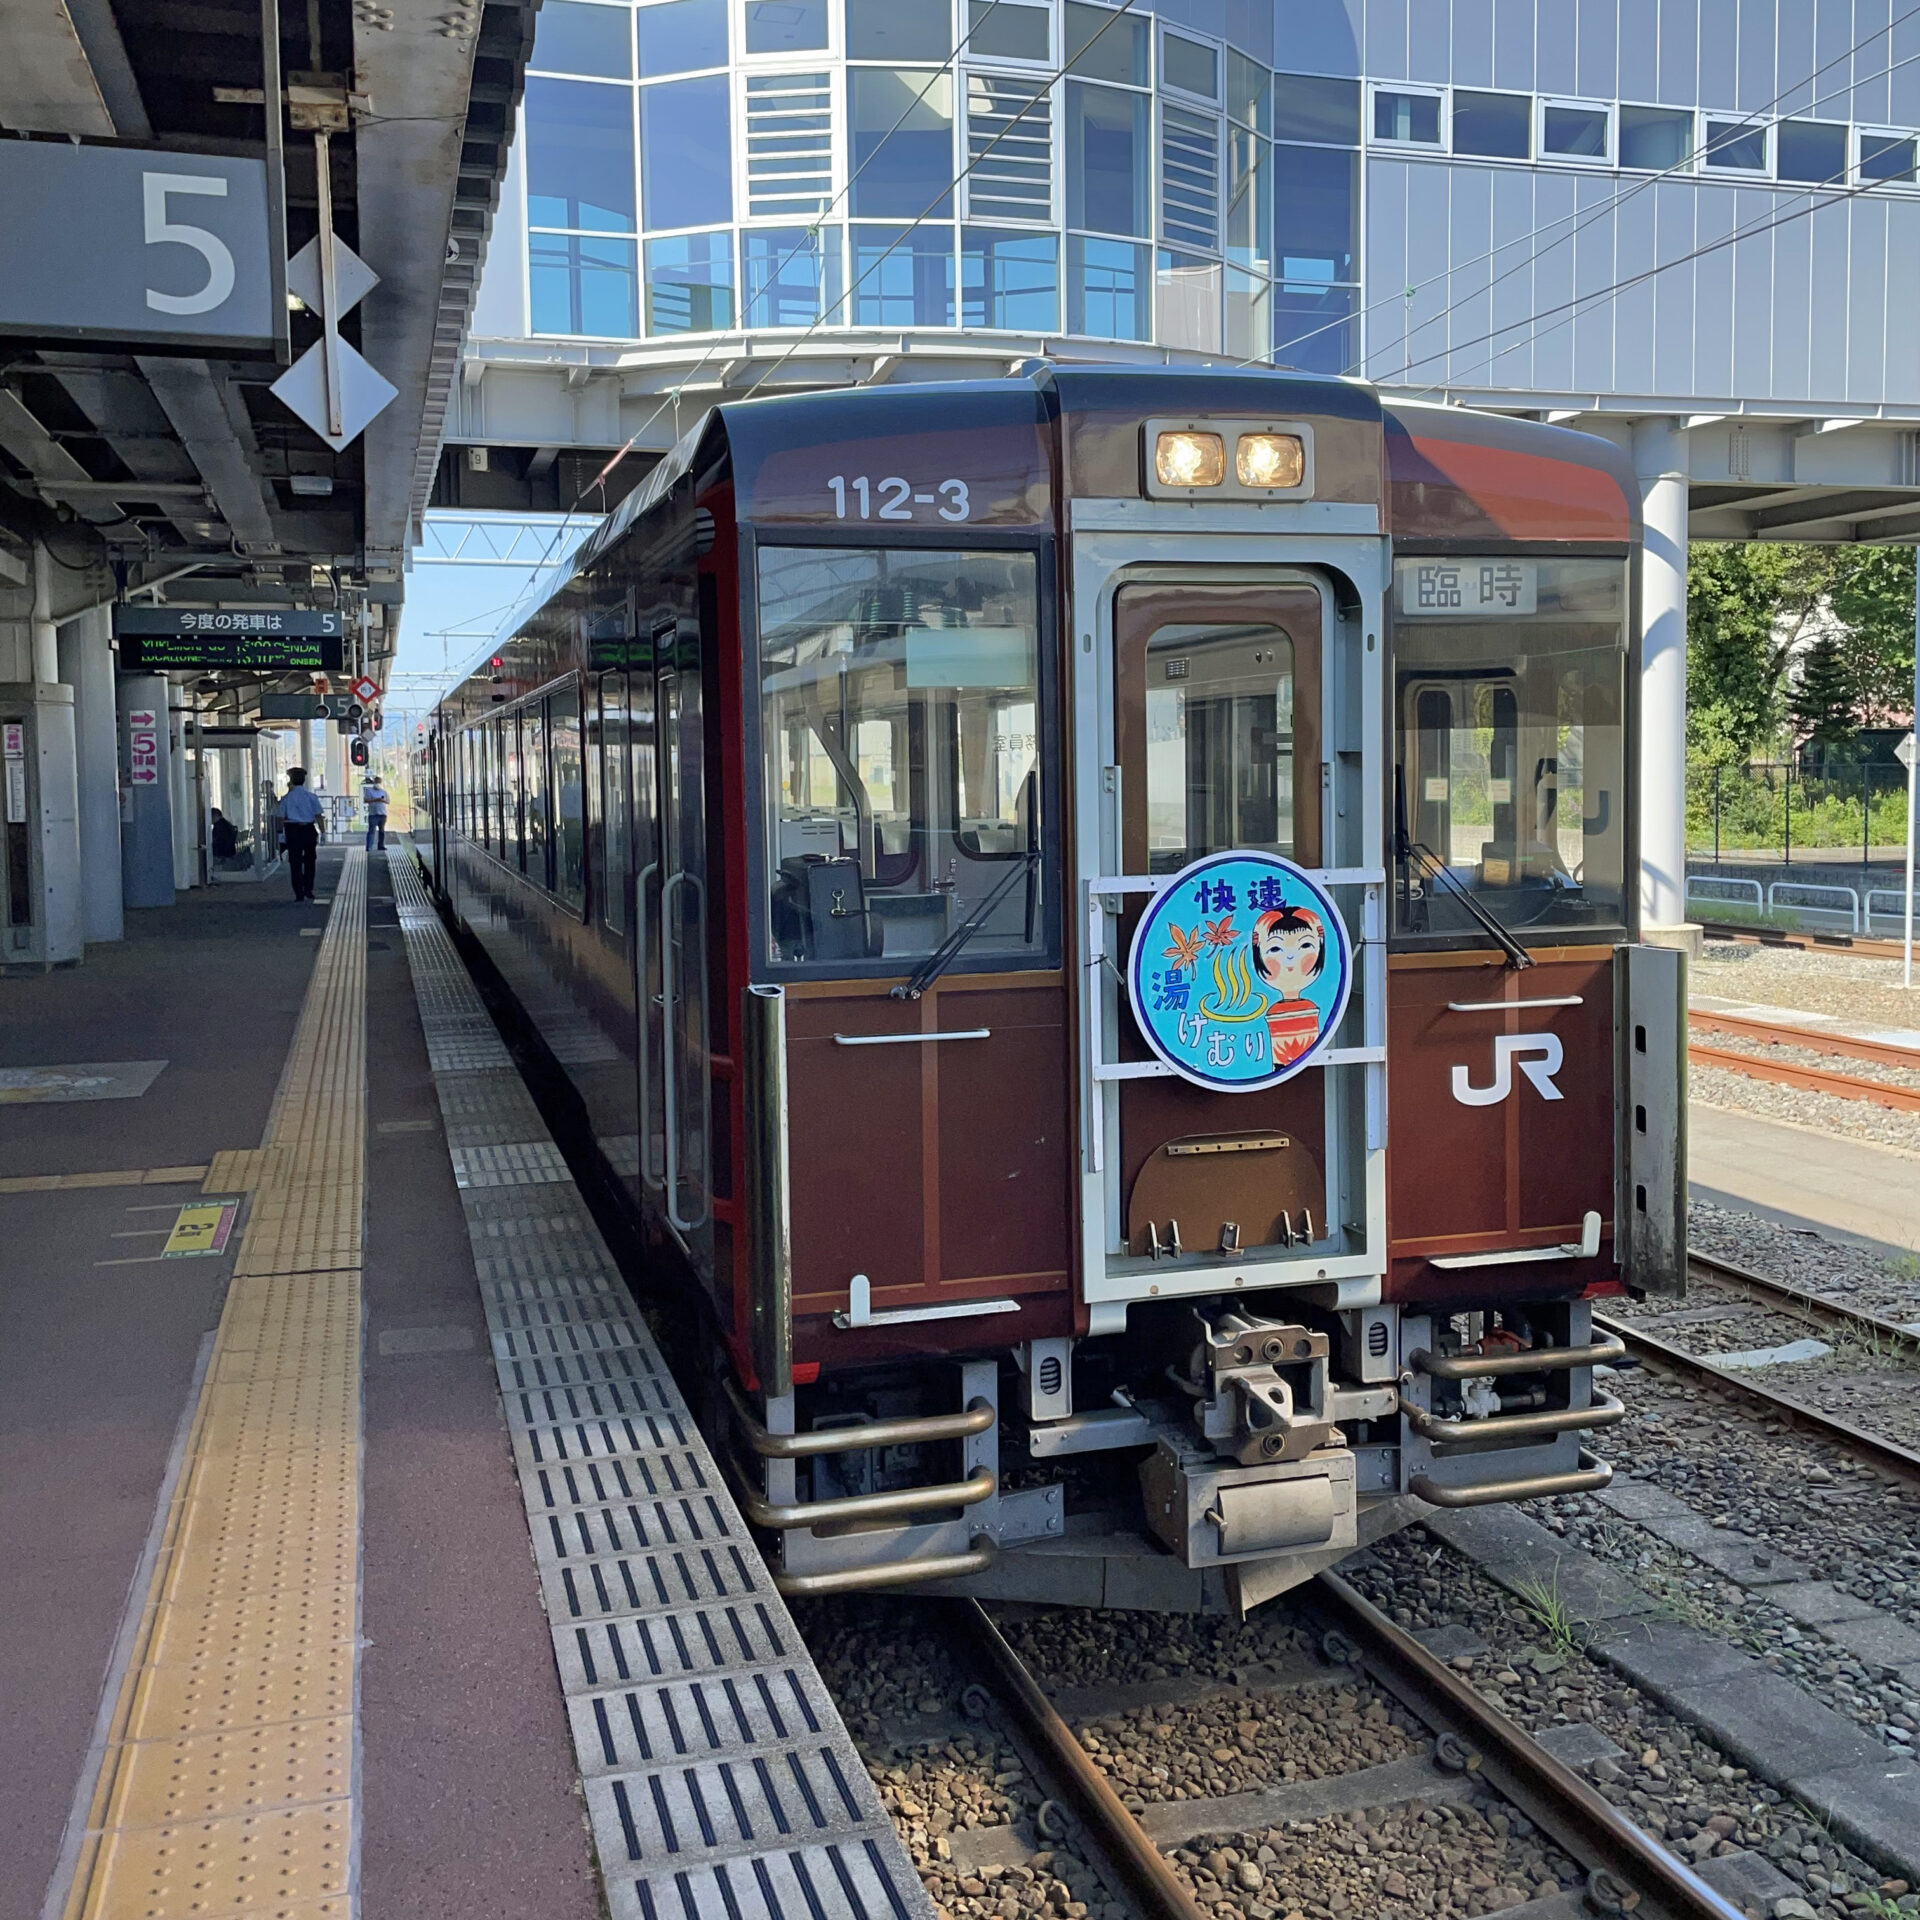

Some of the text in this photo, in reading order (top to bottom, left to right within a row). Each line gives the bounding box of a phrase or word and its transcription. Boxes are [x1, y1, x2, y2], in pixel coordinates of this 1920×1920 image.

[143, 171, 236, 315] 5
[827, 475, 970, 522] 112-3
[1418, 564, 1523, 607] 臨時
[180, 613, 335, 632] 今度の発車は 5
[132, 733, 155, 755] 5
[1194, 876, 1287, 914] 快速
[1452, 1032, 1564, 1106] JR
